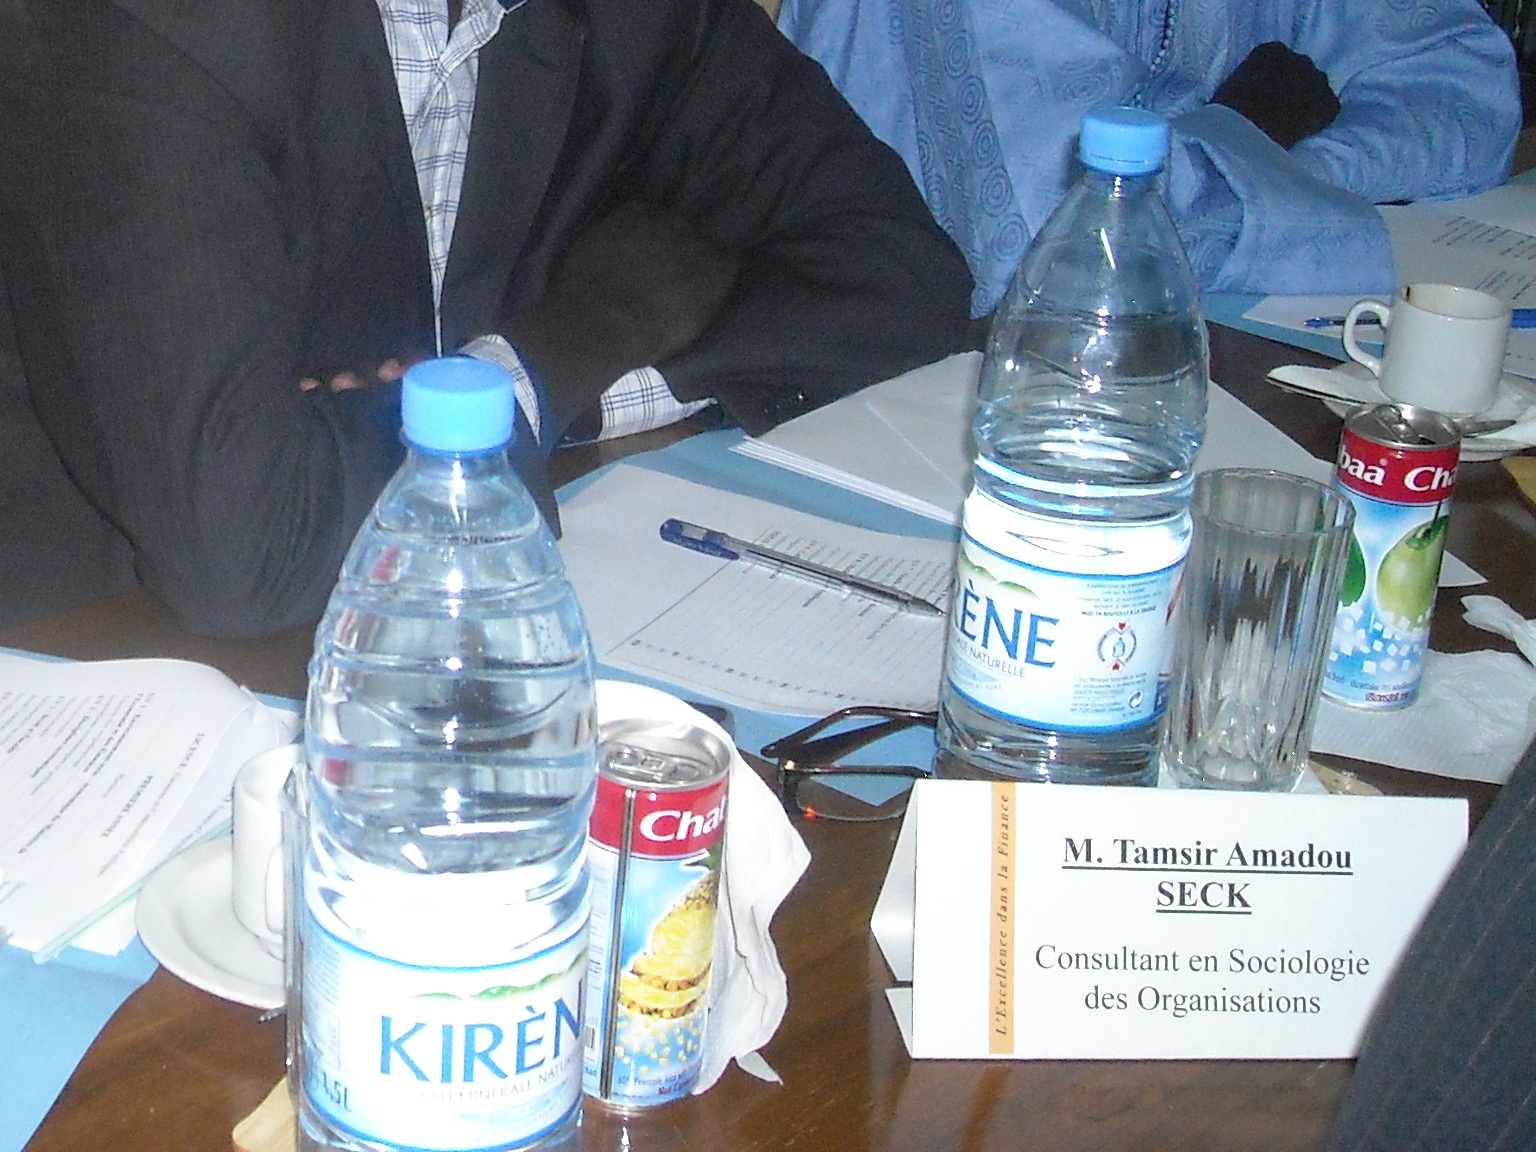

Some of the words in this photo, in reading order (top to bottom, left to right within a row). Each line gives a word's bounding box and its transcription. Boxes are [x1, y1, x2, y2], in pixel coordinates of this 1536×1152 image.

[970, 647, 1026, 678] NATURELLE
[997, 794, 1009, 857] Finance
[1064, 837, 1104, 864] M.
[1113, 838, 1218, 866] Tamsir
[1225, 842, 1352, 868] Amadou
[997, 864, 1008, 880] la
[997, 885, 1009, 924] dans
[1156, 880, 1252, 908] SECK
[1035, 944, 1180, 972] Consultant
[1188, 953, 1218, 972] en
[1229, 948, 1370, 981] Sociologie
[995, 930, 1008, 1036] L'Excellence
[1084, 985, 1128, 1010] des
[1137, 986, 1321, 1018] Organisations
